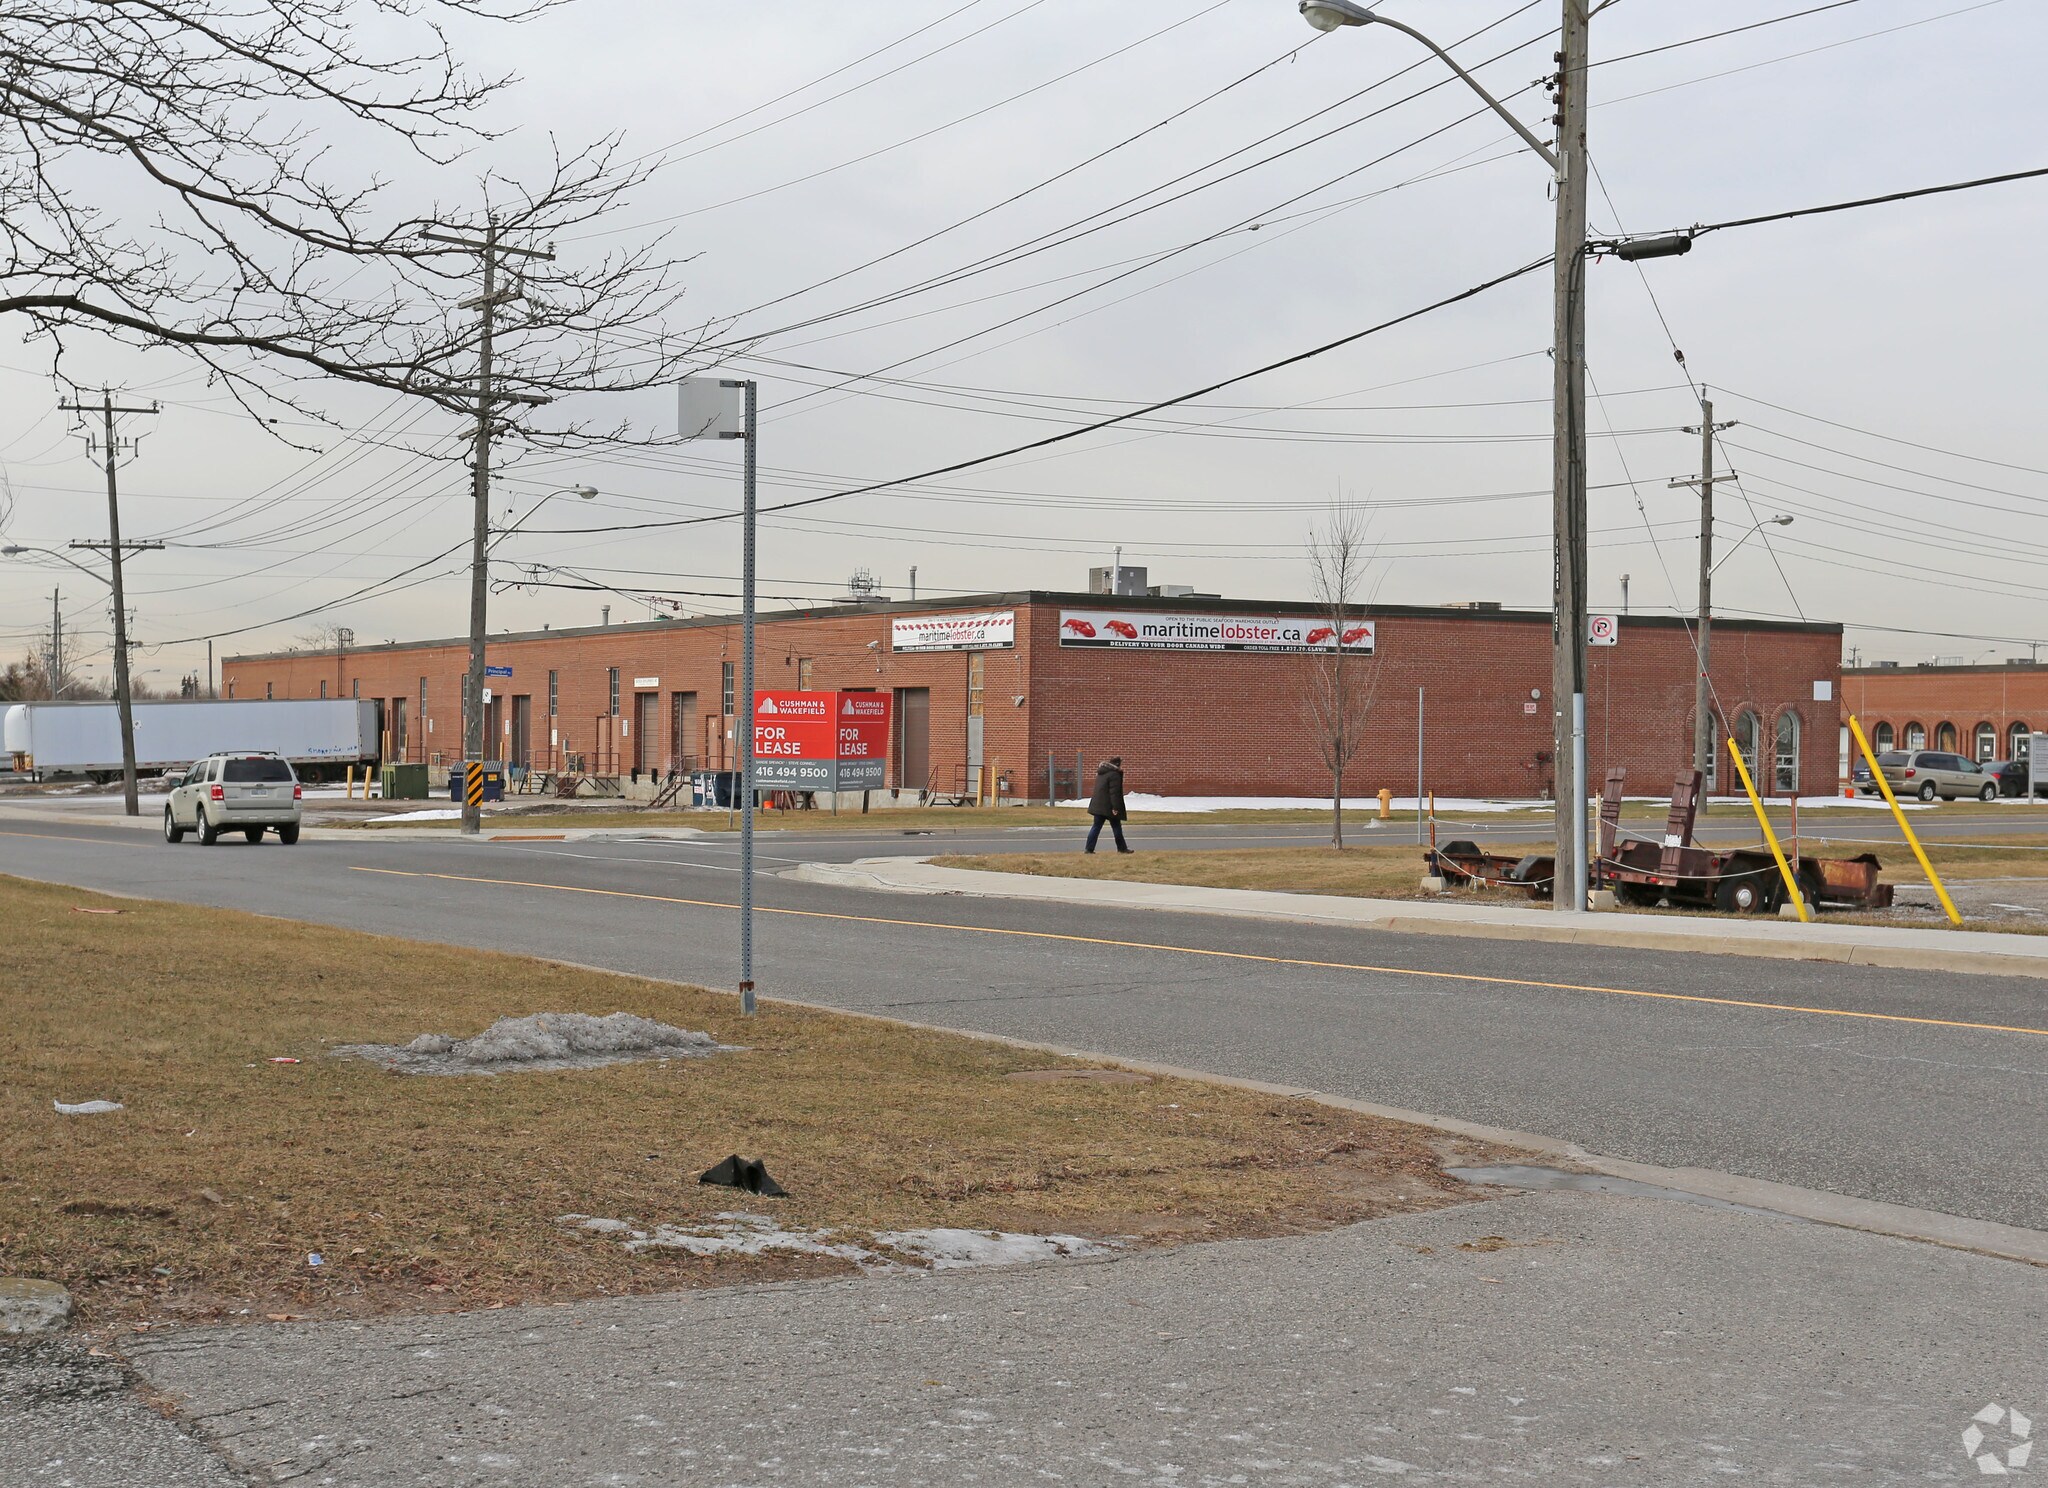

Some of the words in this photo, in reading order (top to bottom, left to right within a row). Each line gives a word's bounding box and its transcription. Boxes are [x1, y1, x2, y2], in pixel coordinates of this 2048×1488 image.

[918, 629, 985, 642] maritimelobster.ca
[1142, 622, 1300, 640] maritimelobster.ca
[780, 700, 818, 708] CUSHMAN
[756, 727, 785, 740] FOR
[840, 728, 859, 740] FOR
[756, 742, 800, 755] LEASE
[840, 743, 868, 756] LEASE
[756, 766, 774, 776] 416
[776, 767, 797, 777] 494
[800, 768, 828, 778] 9500
[840, 768, 850, 778] 416
[852, 768, 864, 778] 494
[866, 767, 882, 777] 9500
